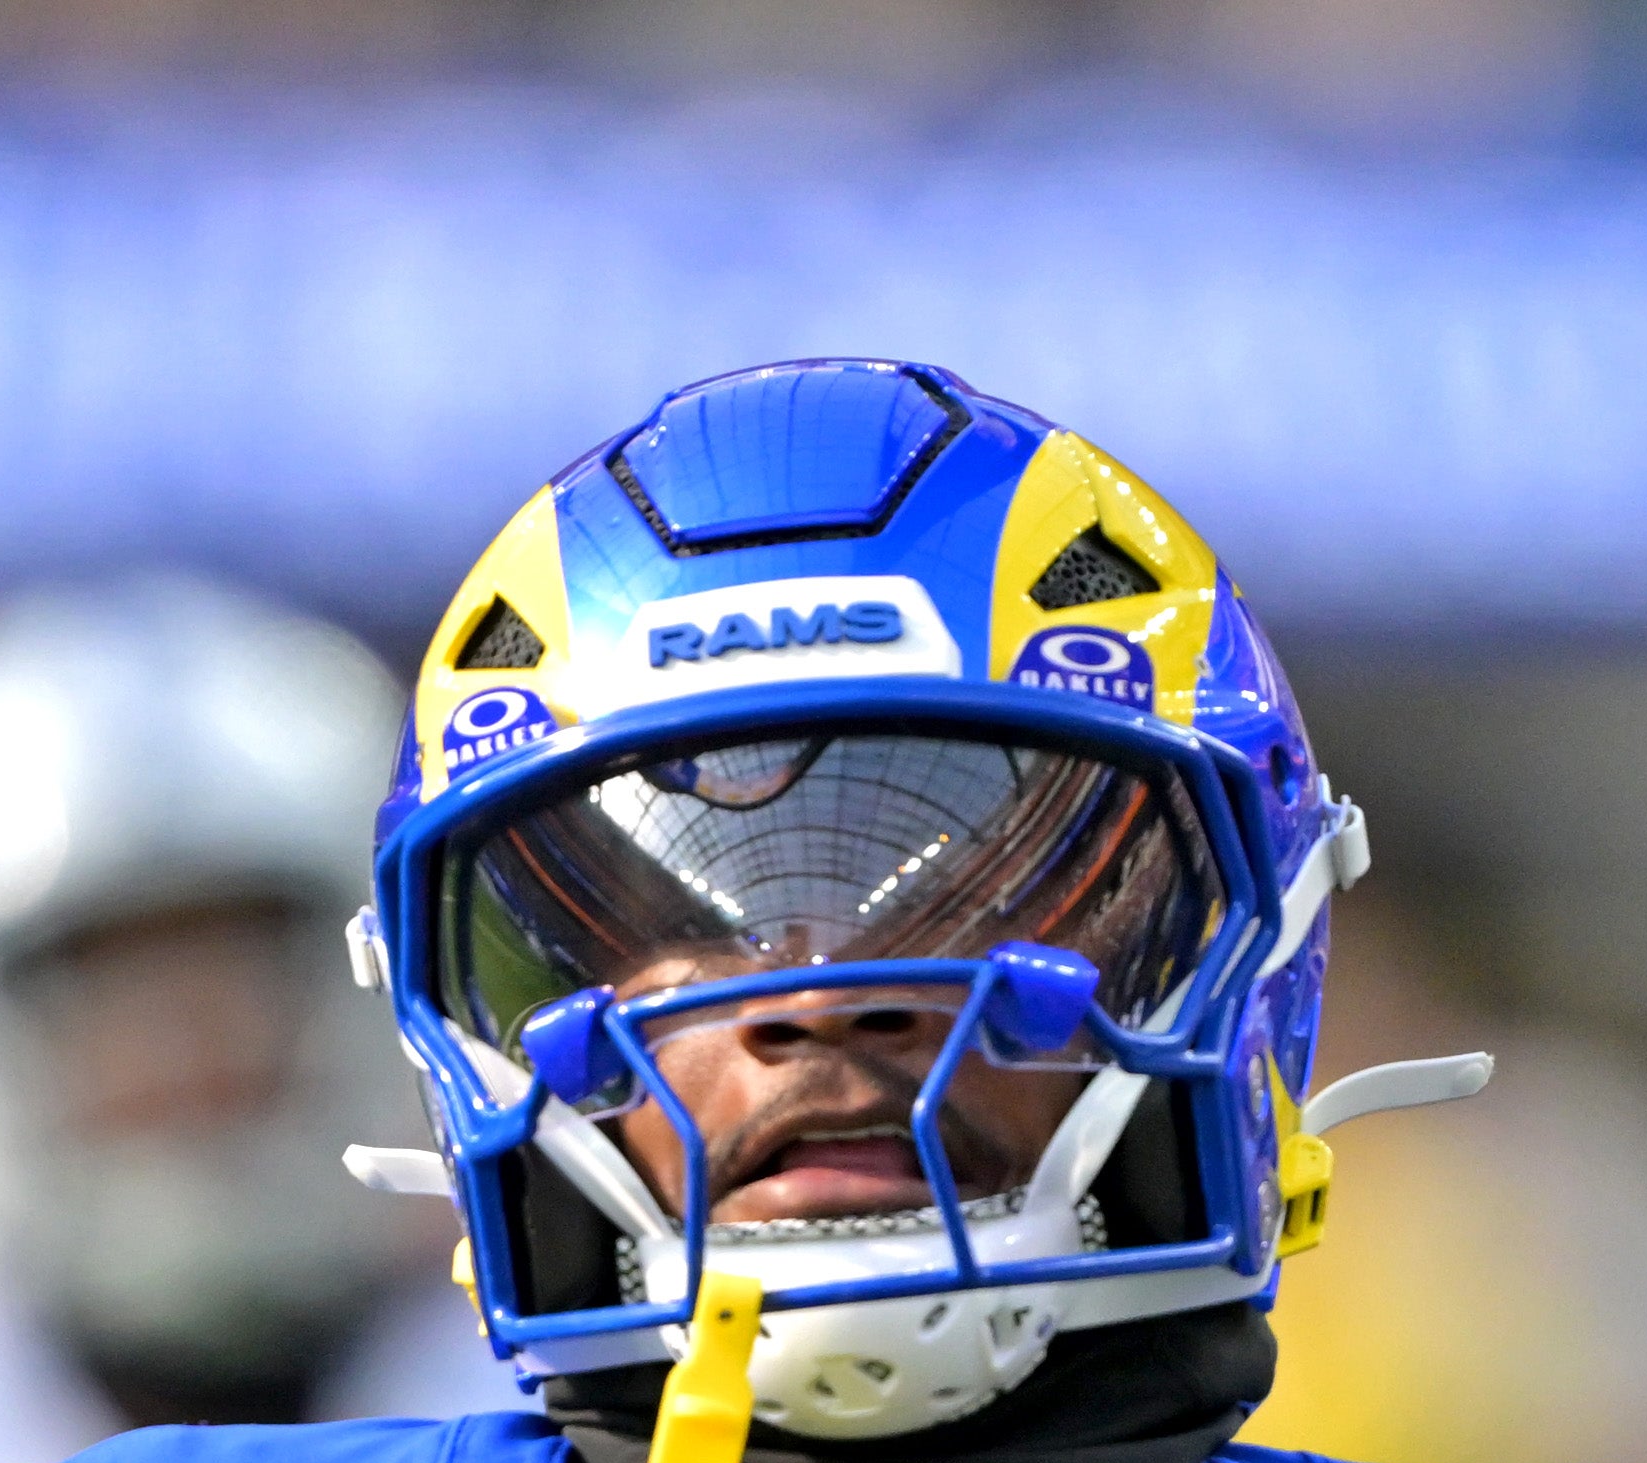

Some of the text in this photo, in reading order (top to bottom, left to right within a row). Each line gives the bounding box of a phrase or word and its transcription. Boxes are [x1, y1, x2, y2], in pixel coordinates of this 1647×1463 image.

[648, 601, 903, 668] RAMS
[1019, 669, 1150, 701] OAKLEY
[444, 720, 548, 769] OAKLEY
